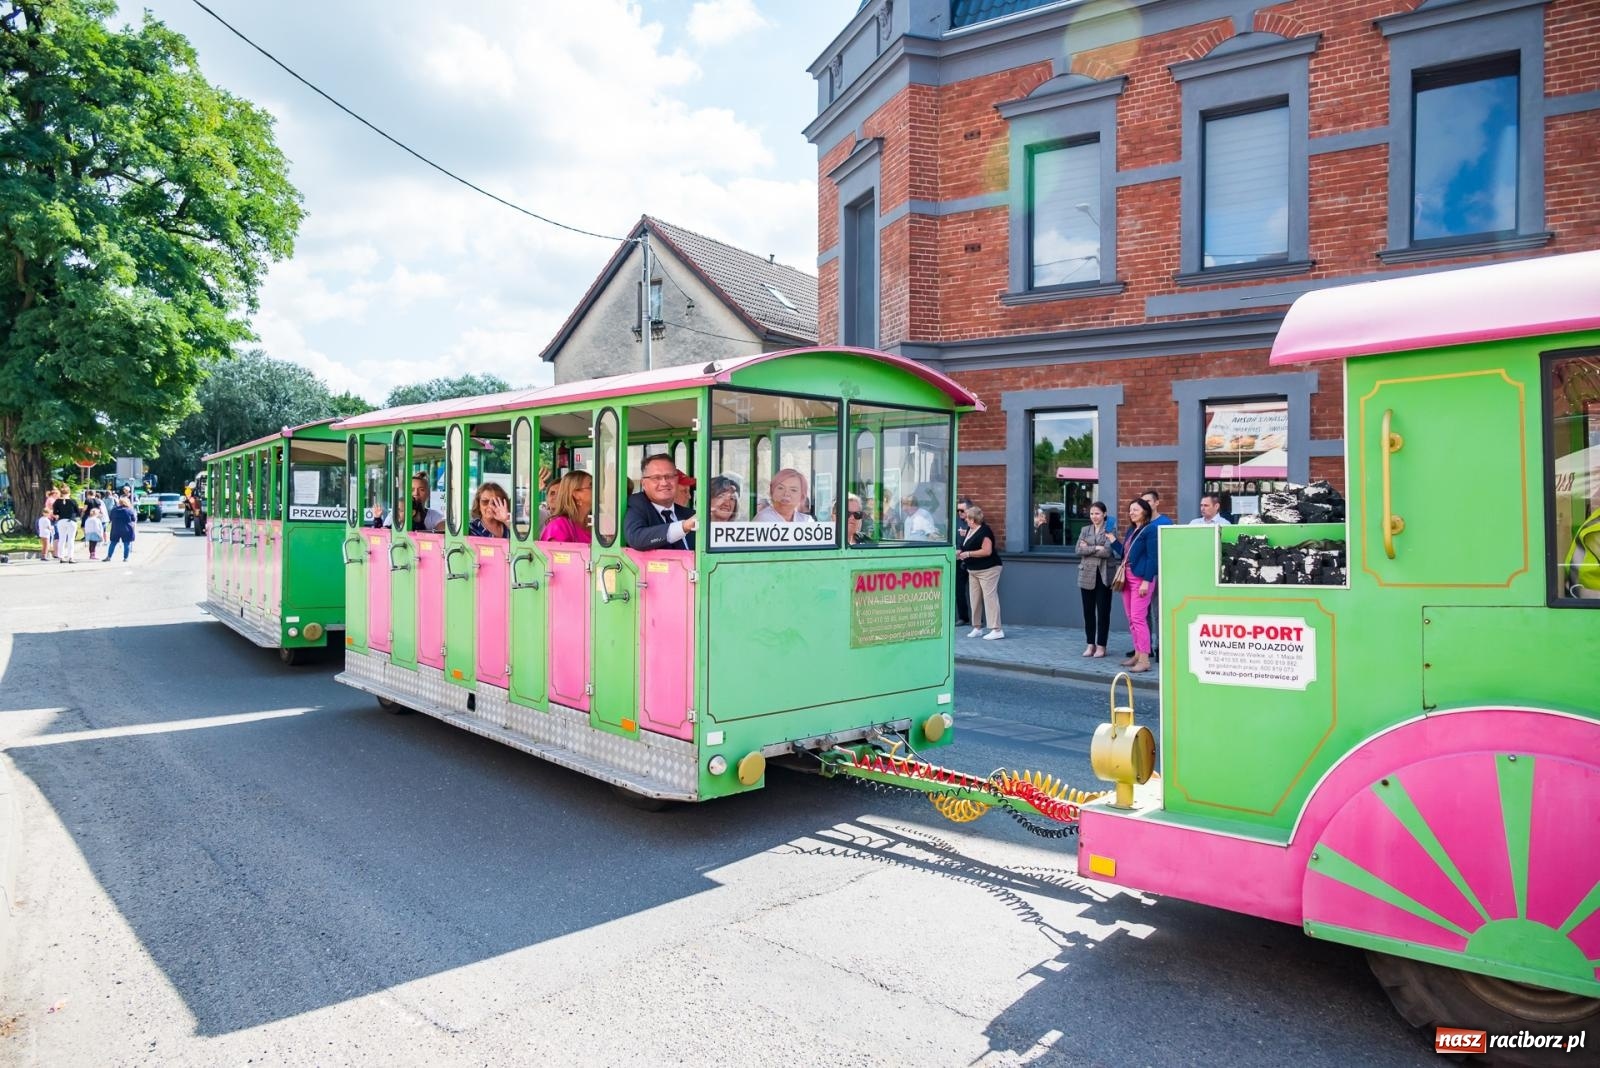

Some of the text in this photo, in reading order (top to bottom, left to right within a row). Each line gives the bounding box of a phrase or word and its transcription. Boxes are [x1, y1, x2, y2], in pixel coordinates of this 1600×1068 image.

[292, 508, 347, 518] PRZEWÓZ
[714, 523, 833, 543] PRZEWÓZ OSÓB
[855, 570, 941, 593] AUTO-PORT
[897, 590, 941, 603] POJAZDÓW
[1199, 623, 1304, 642] AUTO-PORT
[1199, 640, 1304, 653] WYNAJEM POJAZDÓW
[1205, 670, 1299, 682] www.auto-port.pietrowice.pl
